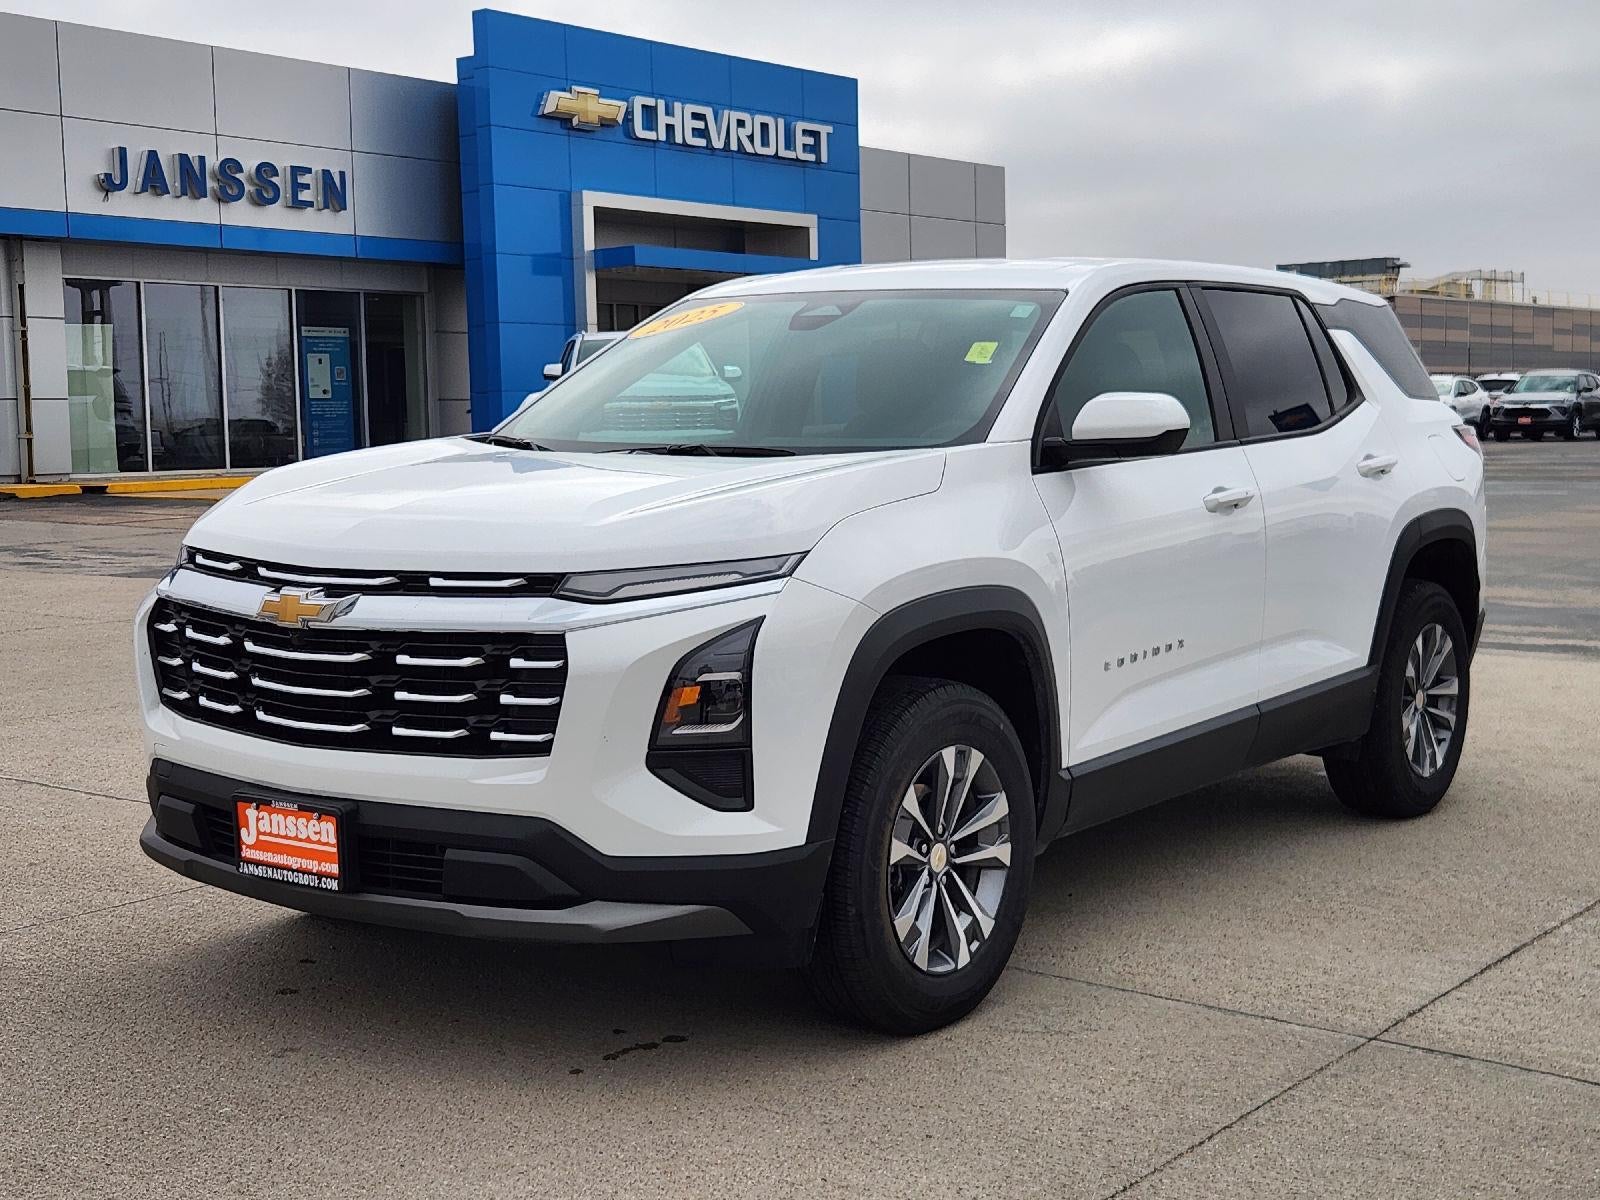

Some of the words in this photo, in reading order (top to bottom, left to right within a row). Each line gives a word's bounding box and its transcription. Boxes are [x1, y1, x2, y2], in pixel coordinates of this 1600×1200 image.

[631, 95, 833, 163] CHEVROLET
[98, 146, 348, 212] JANSSEN
[1103, 638, 1185, 672] EQUINOX
[240, 807, 338, 845] Janssen
[239, 861, 339, 891] JANSSENAUTOGROUP.COM
[240, 845, 339, 873] Janssenautogroup.com
